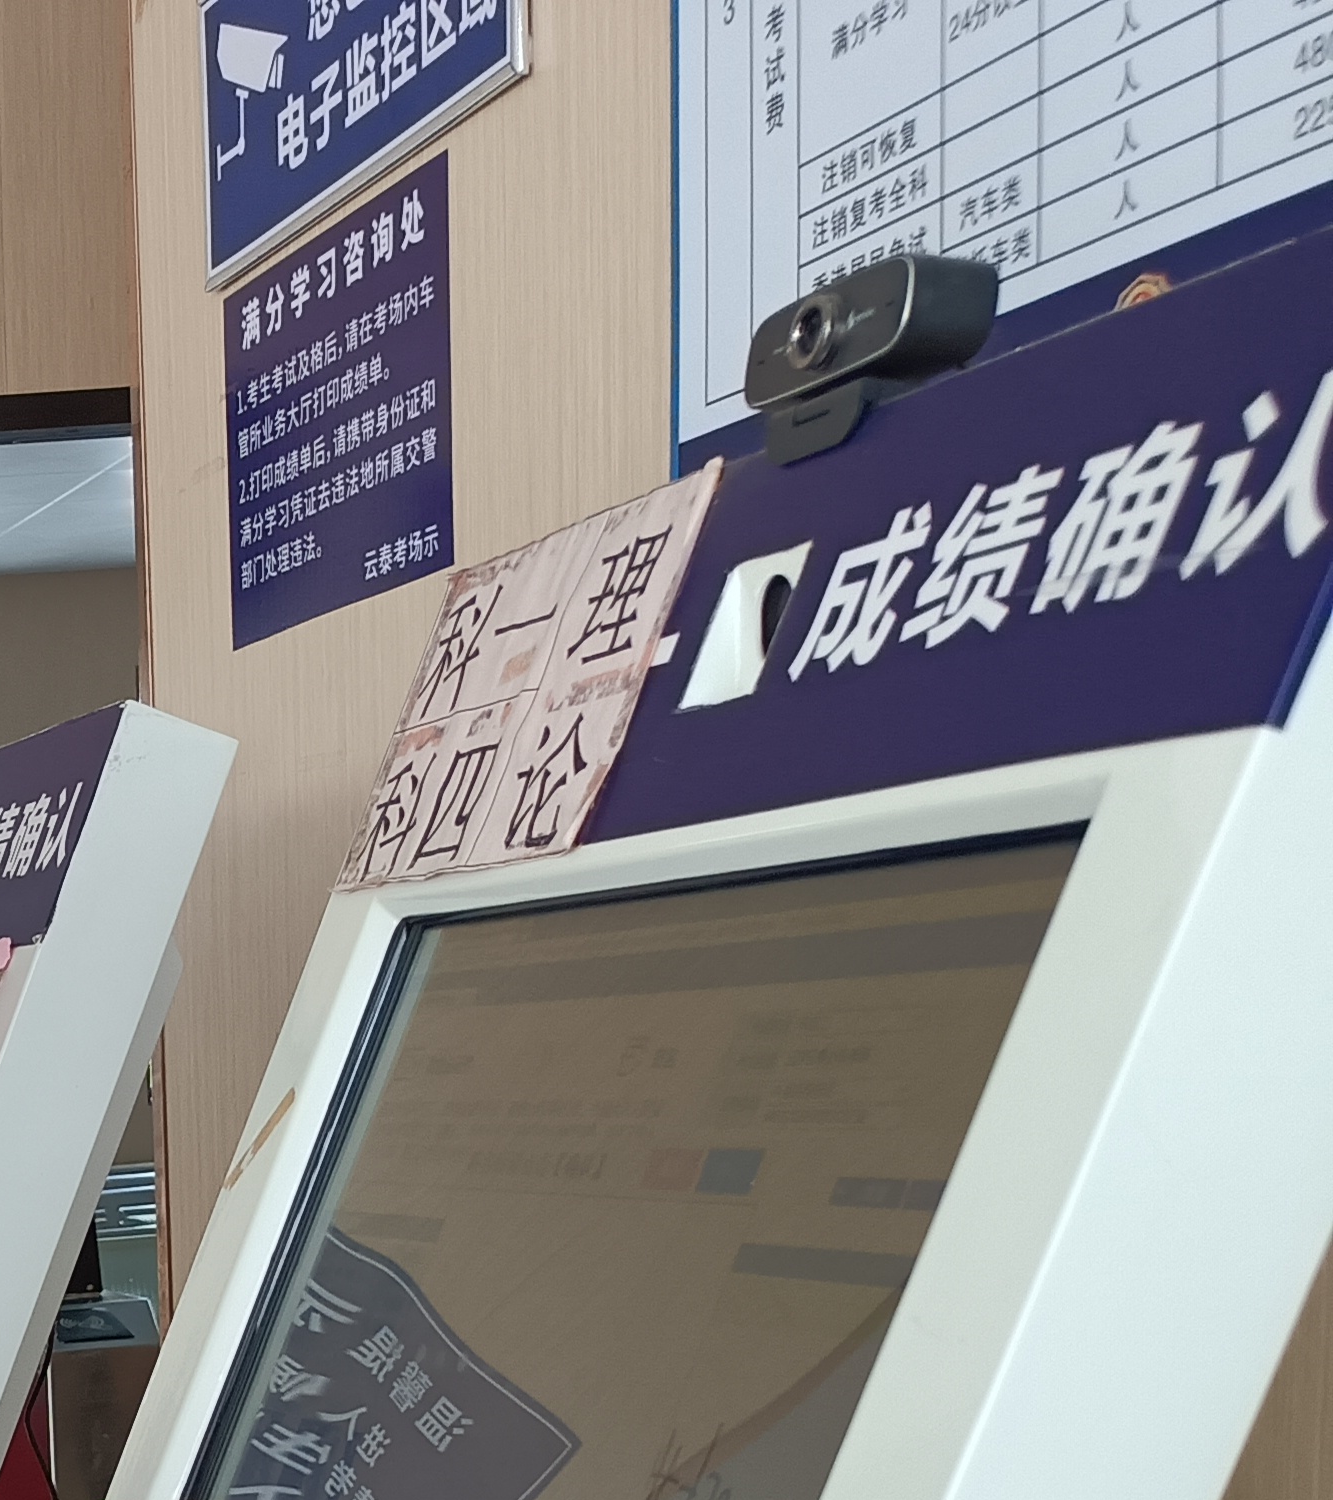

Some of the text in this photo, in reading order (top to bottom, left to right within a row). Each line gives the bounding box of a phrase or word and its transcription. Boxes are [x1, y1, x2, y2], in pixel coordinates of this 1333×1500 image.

[812, 163, 928, 250] 注销复考全科
[822, 116, 918, 194] 注销可恢复
[959, 174, 1023, 232] 汽车类
[240, 188, 426, 351] 满分学习咨询处
[239, 427, 437, 548] 满分学习凭证去违法地所属交警
[789, 368, 1333, 682] 成绩确认
[363, 524, 440, 580] 云泰考场示
[417, 524, 673, 720] 科一 理
[356, 712, 588, 883] 科四 论
